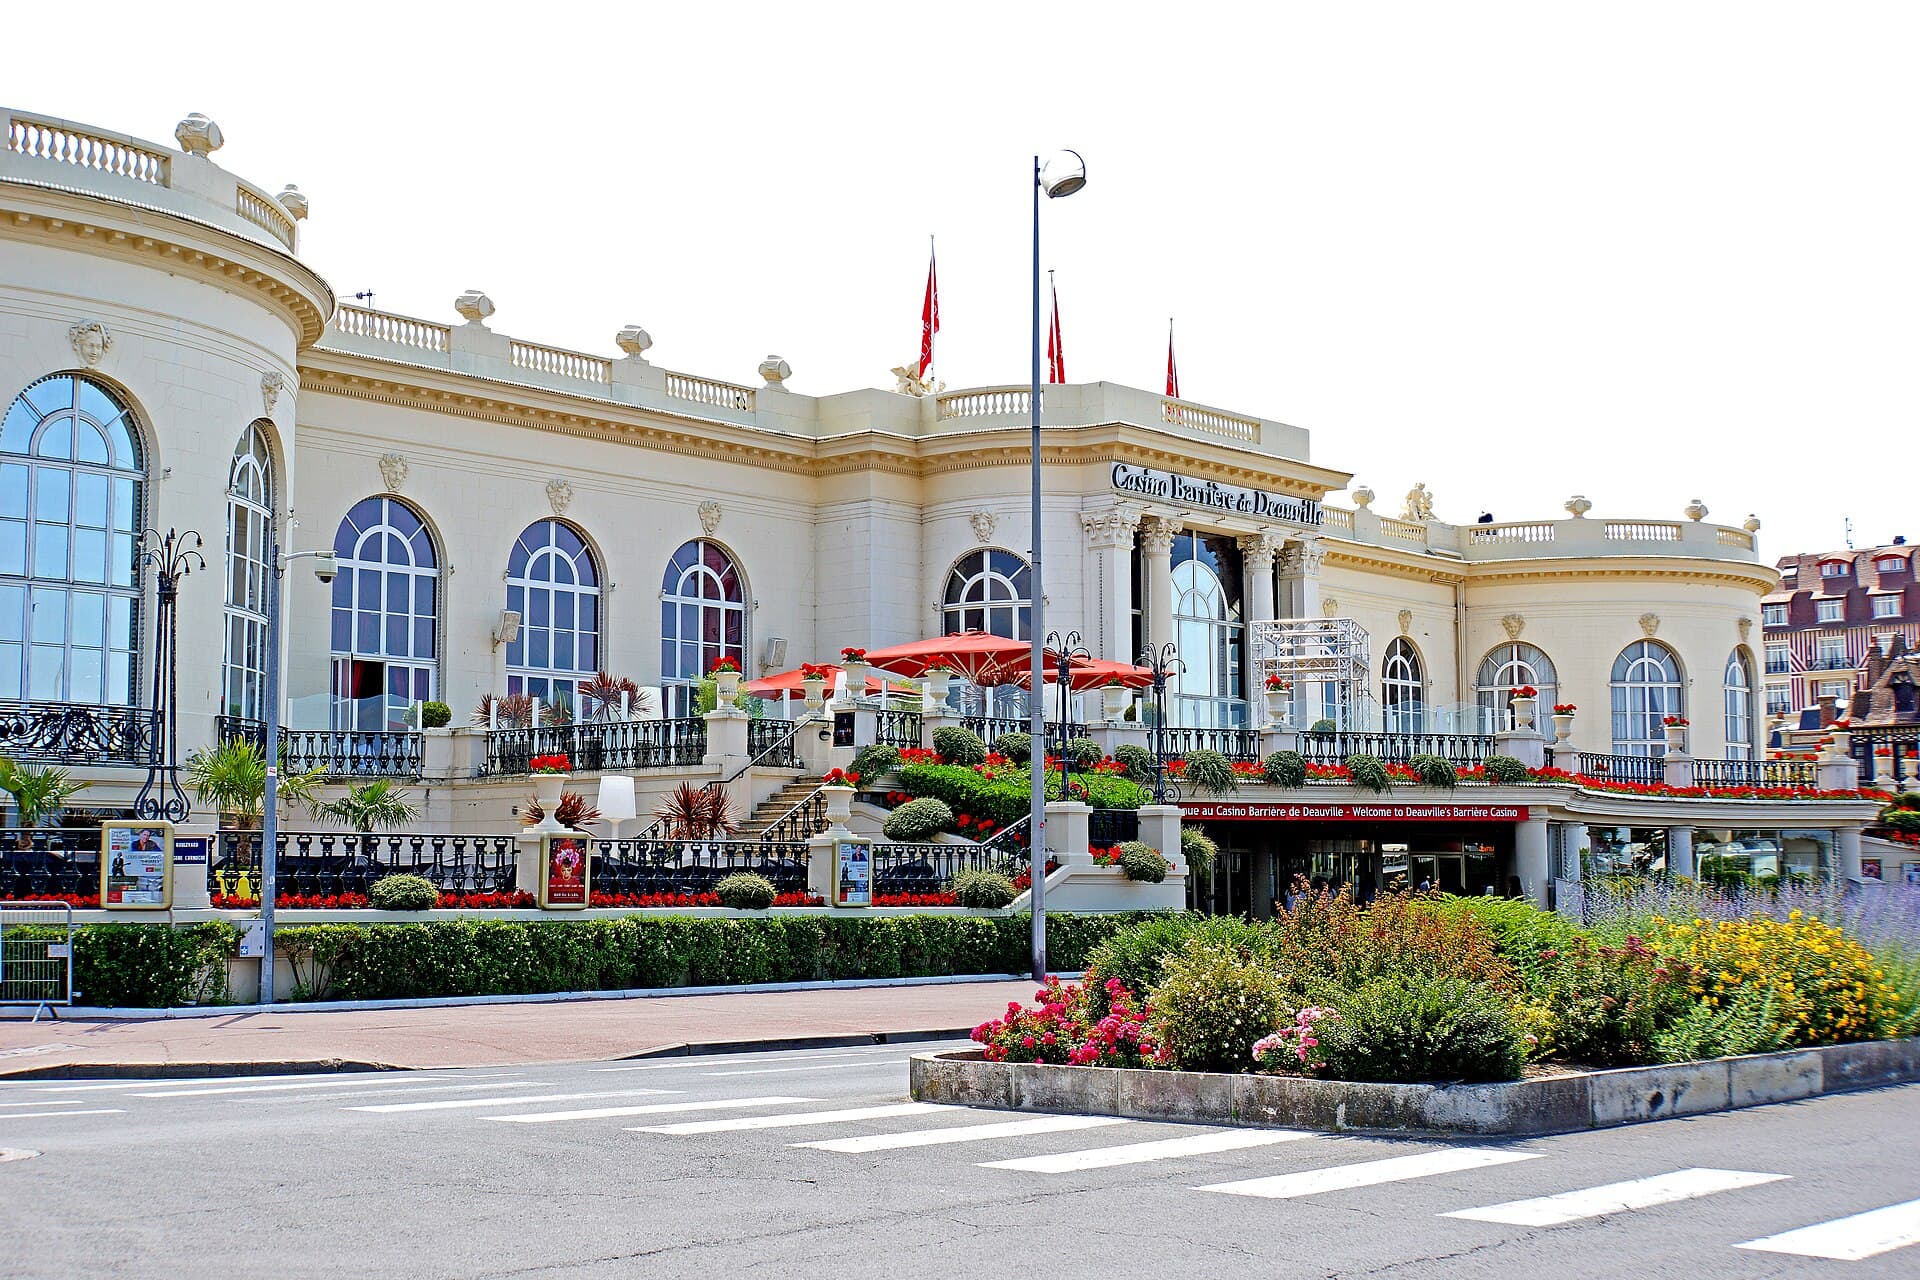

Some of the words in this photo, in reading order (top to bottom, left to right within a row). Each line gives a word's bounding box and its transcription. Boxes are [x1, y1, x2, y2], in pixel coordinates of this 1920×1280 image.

[1112, 463, 1170, 497] Casino
[1171, 474, 1236, 509] Barrière
[1236, 493, 1253, 512] de
[1254, 490, 1324, 525] Deauville
[1202, 807, 1214, 816] au
[1216, 805, 1246, 816] Casino
[1249, 805, 1286, 817] Barrière
[1289, 805, 1300, 817] de
[1303, 806, 1344, 817] Deauville
[1352, 806, 1392, 817] Welcome
[1394, 806, 1404, 817] to
[1406, 806, 1451, 817] Deauville's
[1453, 806, 1488, 817] Barrière
[1490, 806, 1518, 817] Casino
